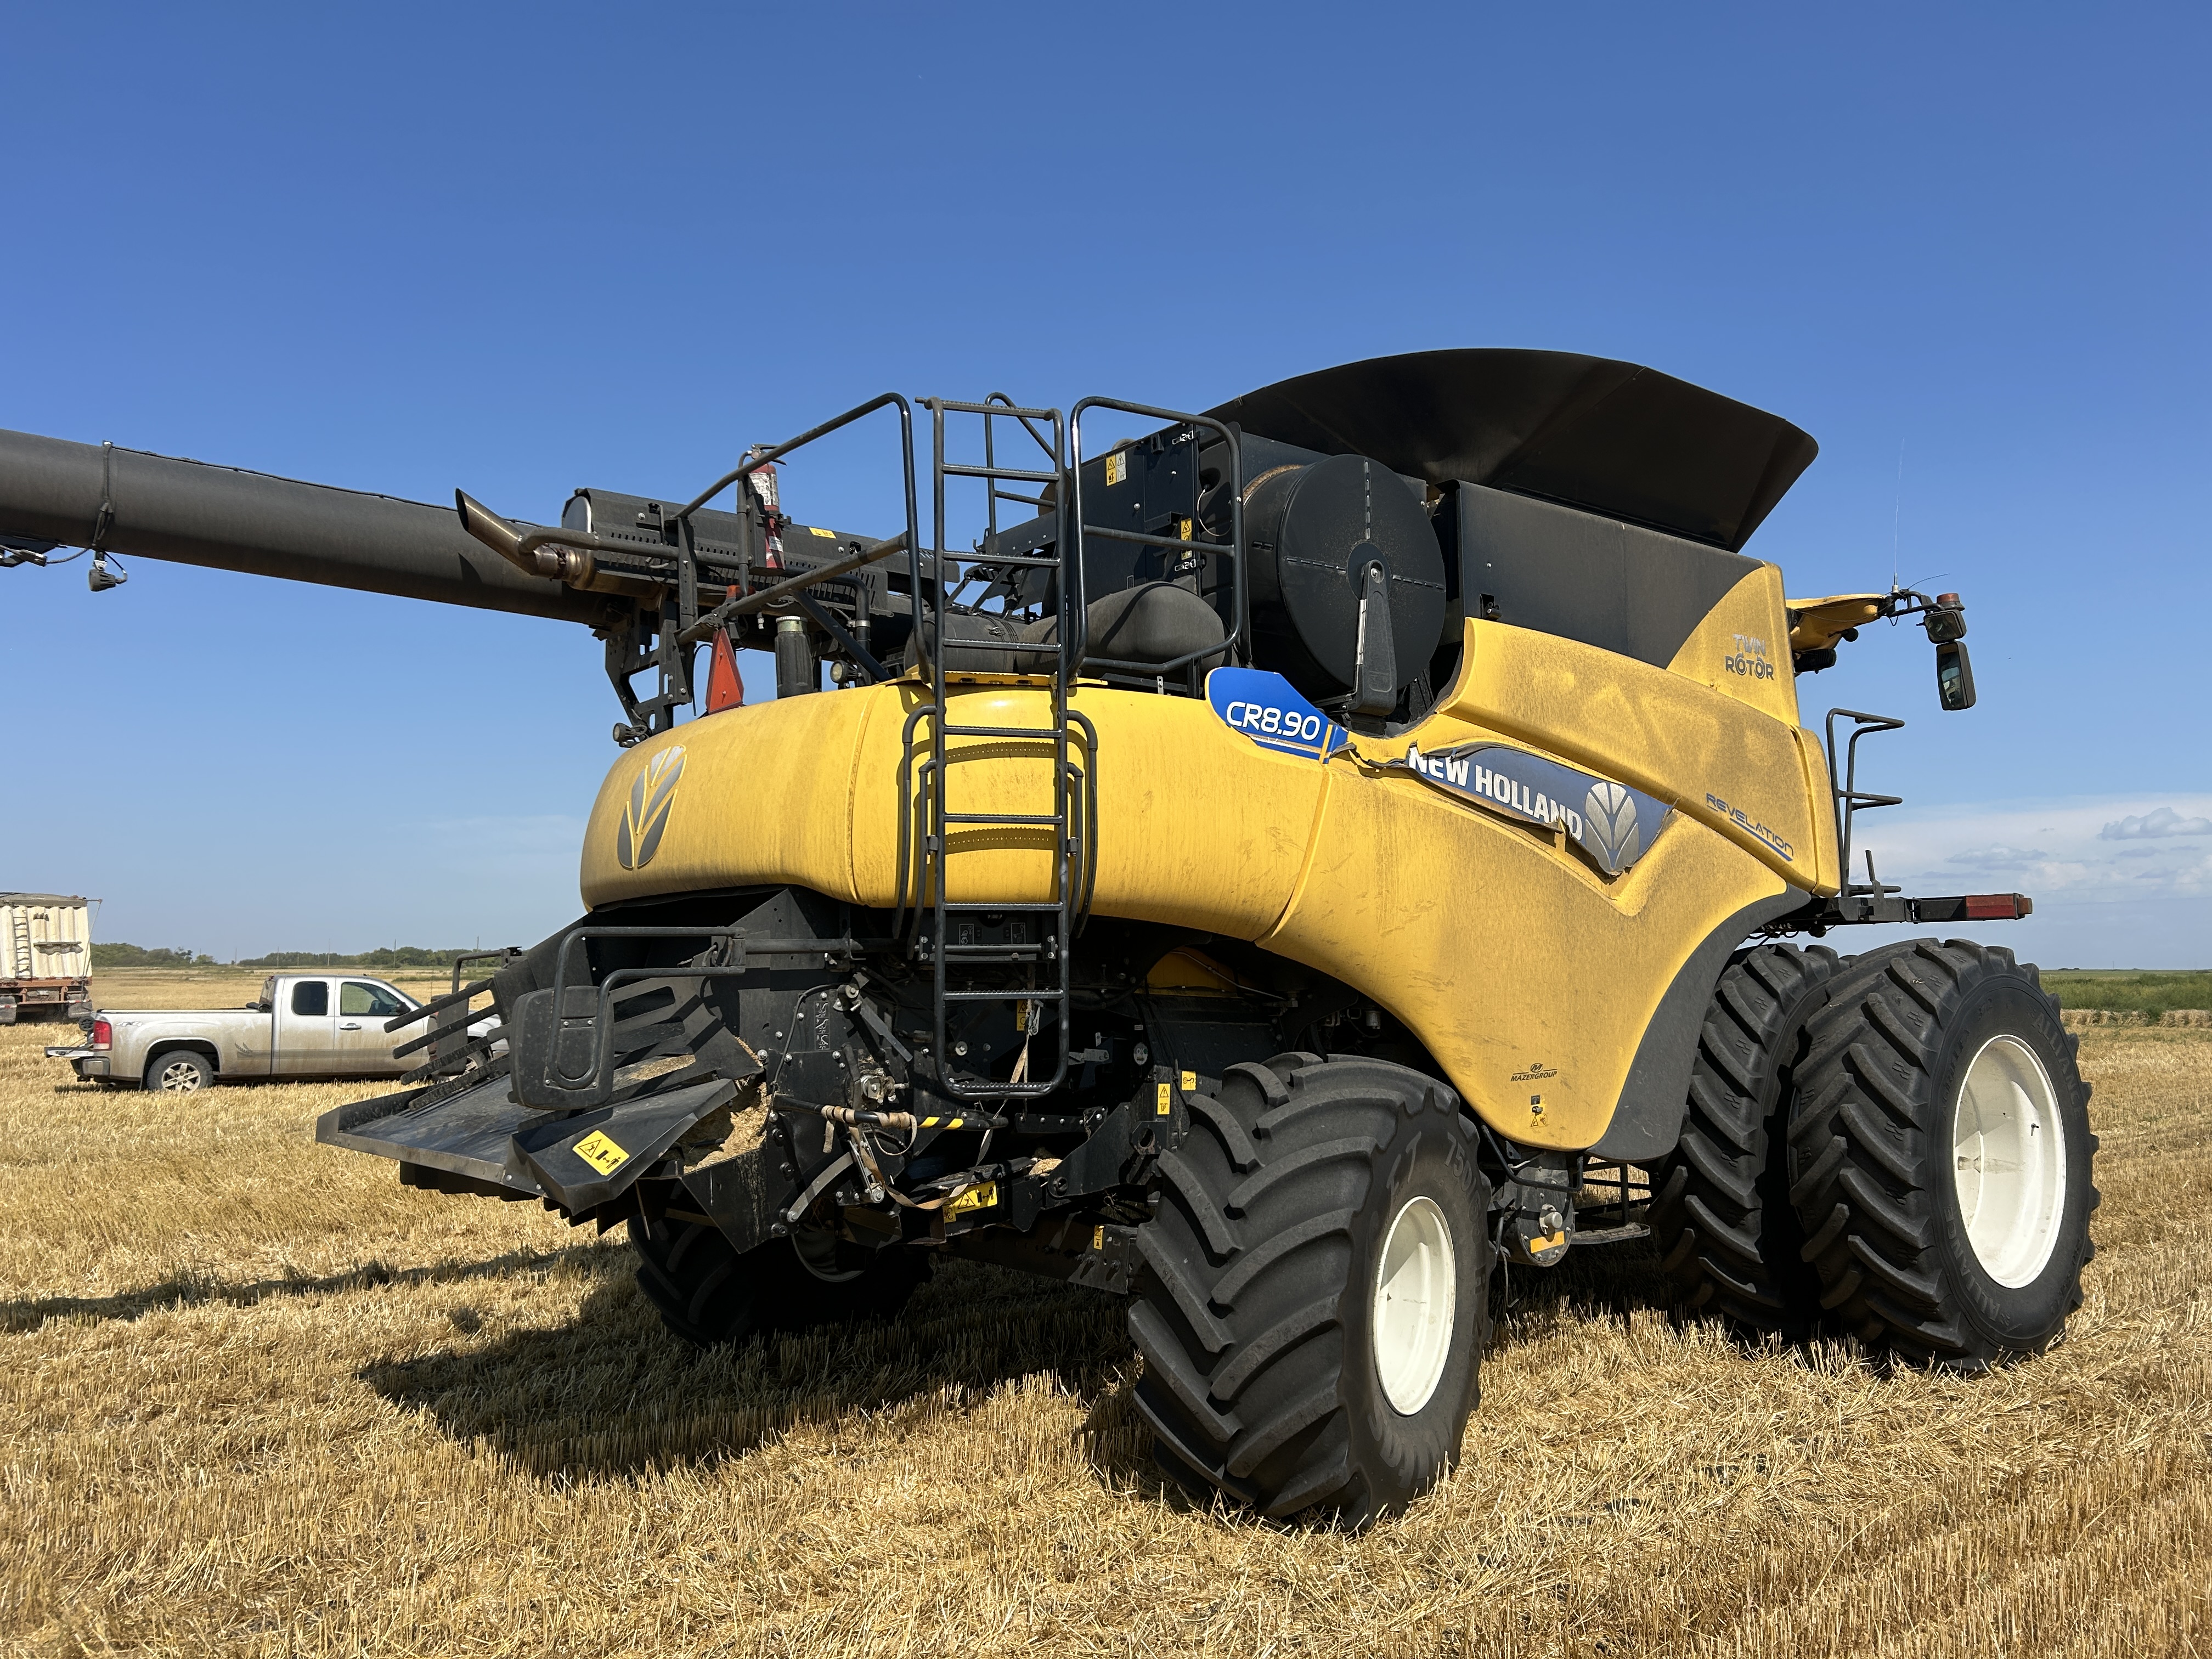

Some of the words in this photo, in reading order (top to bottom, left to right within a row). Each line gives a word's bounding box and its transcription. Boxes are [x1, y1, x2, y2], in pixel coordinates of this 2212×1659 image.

[1725, 652, 1774, 680] ROTOR
[1733, 634, 1766, 656] TWIN
[1227, 701, 1321, 741] CR8.90
[1409, 747, 1469, 787] NEW
[1475, 765, 1583, 840] HOLLAND
[1706, 793, 1794, 857] REVELATION
[1510, 1071, 1558, 1082] MAZERGROUP
[2031, 1012, 2084, 1120] ALLIANCE
[1943, 1204, 2001, 1322] ALLIANCE
